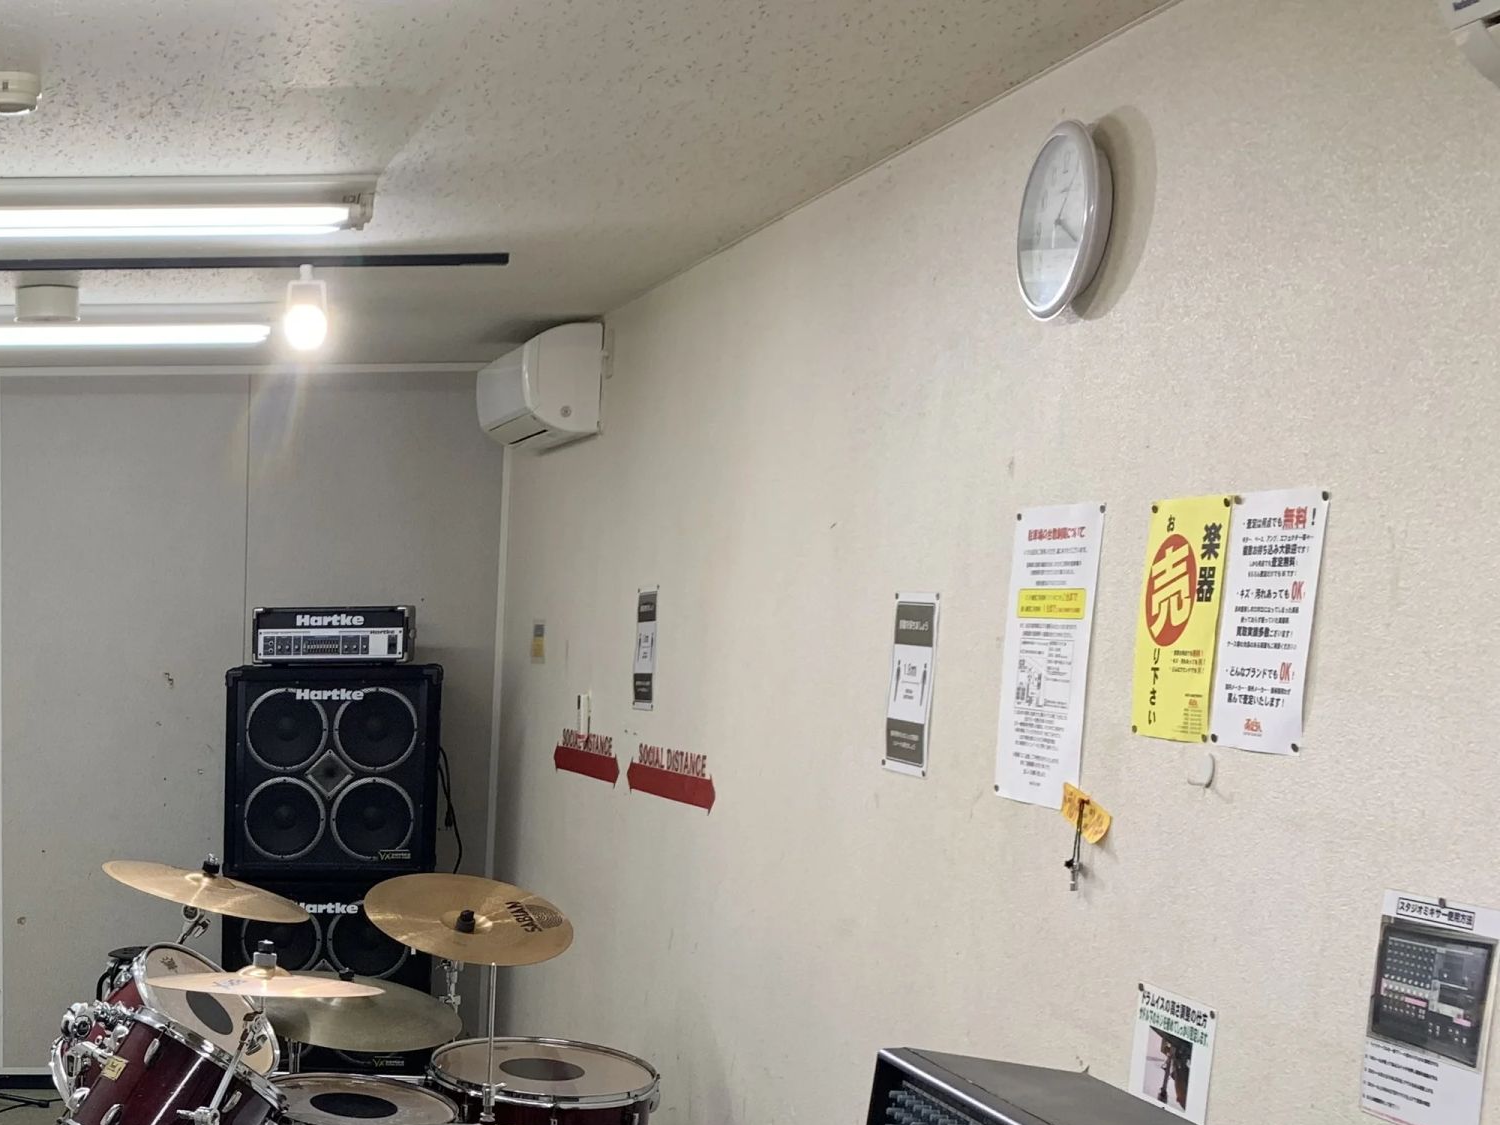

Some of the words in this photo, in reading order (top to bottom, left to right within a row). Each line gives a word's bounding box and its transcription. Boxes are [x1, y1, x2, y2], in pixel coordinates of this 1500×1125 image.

[1196, 522, 1223, 602] 楽器
[296, 613, 365, 626] Hartke
[295, 688, 364, 701] Hartke
[638, 743, 665, 769] SOCIAL
[667, 748, 708, 777] DISTANCE
[505, 901, 543, 933] SABIAN
